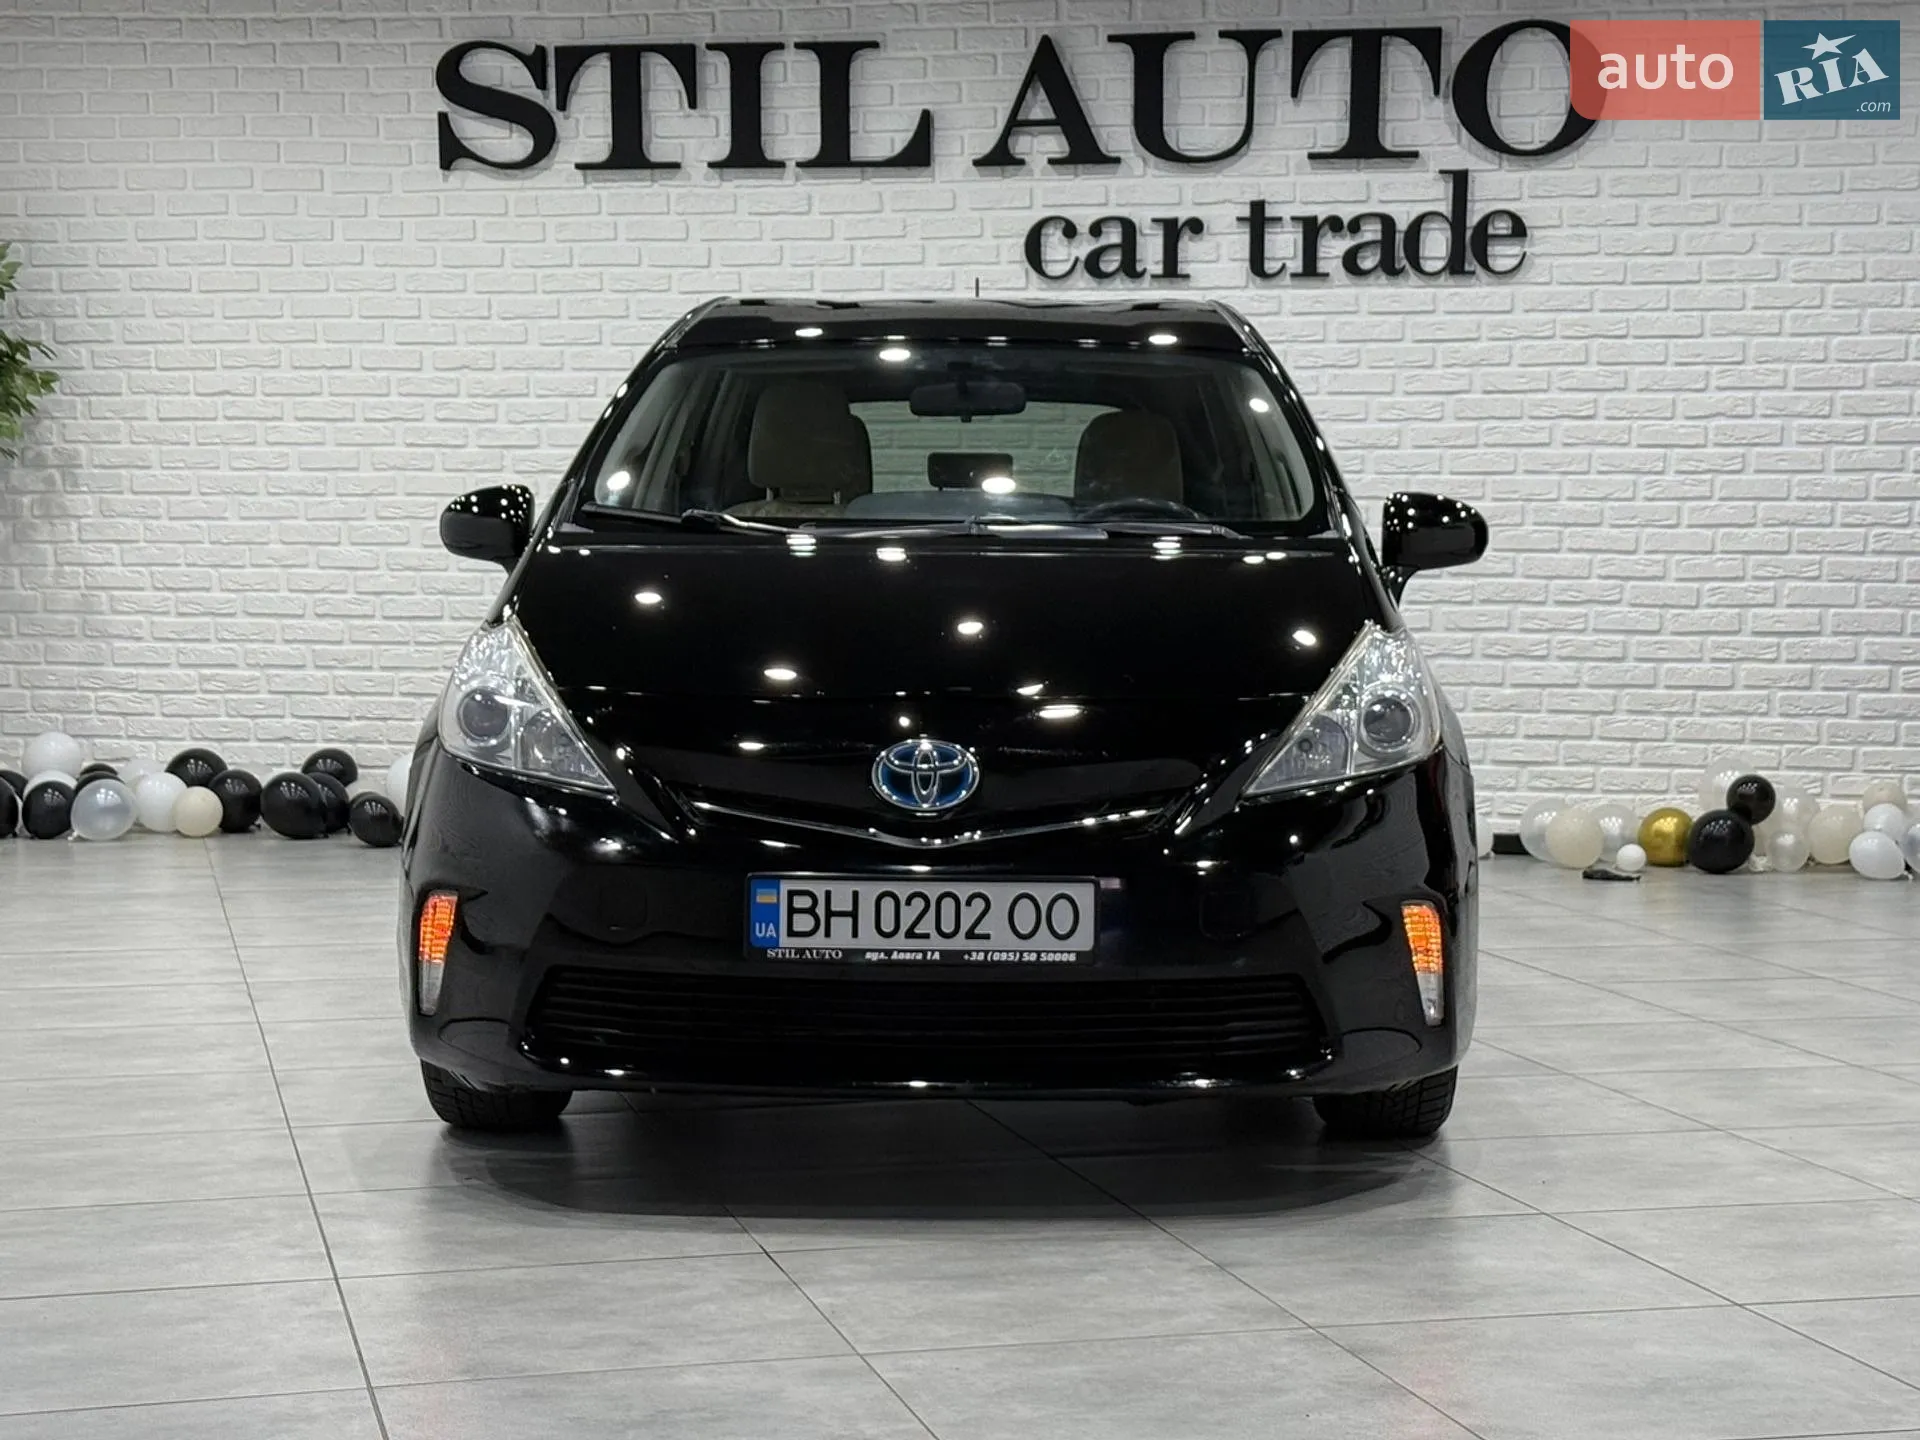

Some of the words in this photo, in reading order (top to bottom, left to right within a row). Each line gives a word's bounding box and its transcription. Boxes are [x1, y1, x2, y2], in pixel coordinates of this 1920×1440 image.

[436, 40, 931, 170] STIL
[972, 19, 1607, 167] AUTO
[1024, 215, 1204, 280] car
[1236, 168, 1527, 279] trade
[755, 922, 777, 938] UA
[786, 889, 859, 939] BH
[874, 890, 992, 940] 0202
[1008, 891, 1080, 941] OO
[766, 948, 799, 959] STIL
[802, 949, 843, 959] AUTO
[963, 951, 985, 962] +38
[987, 951, 1020, 962] (095)
[1021, 951, 1038, 962] 50
